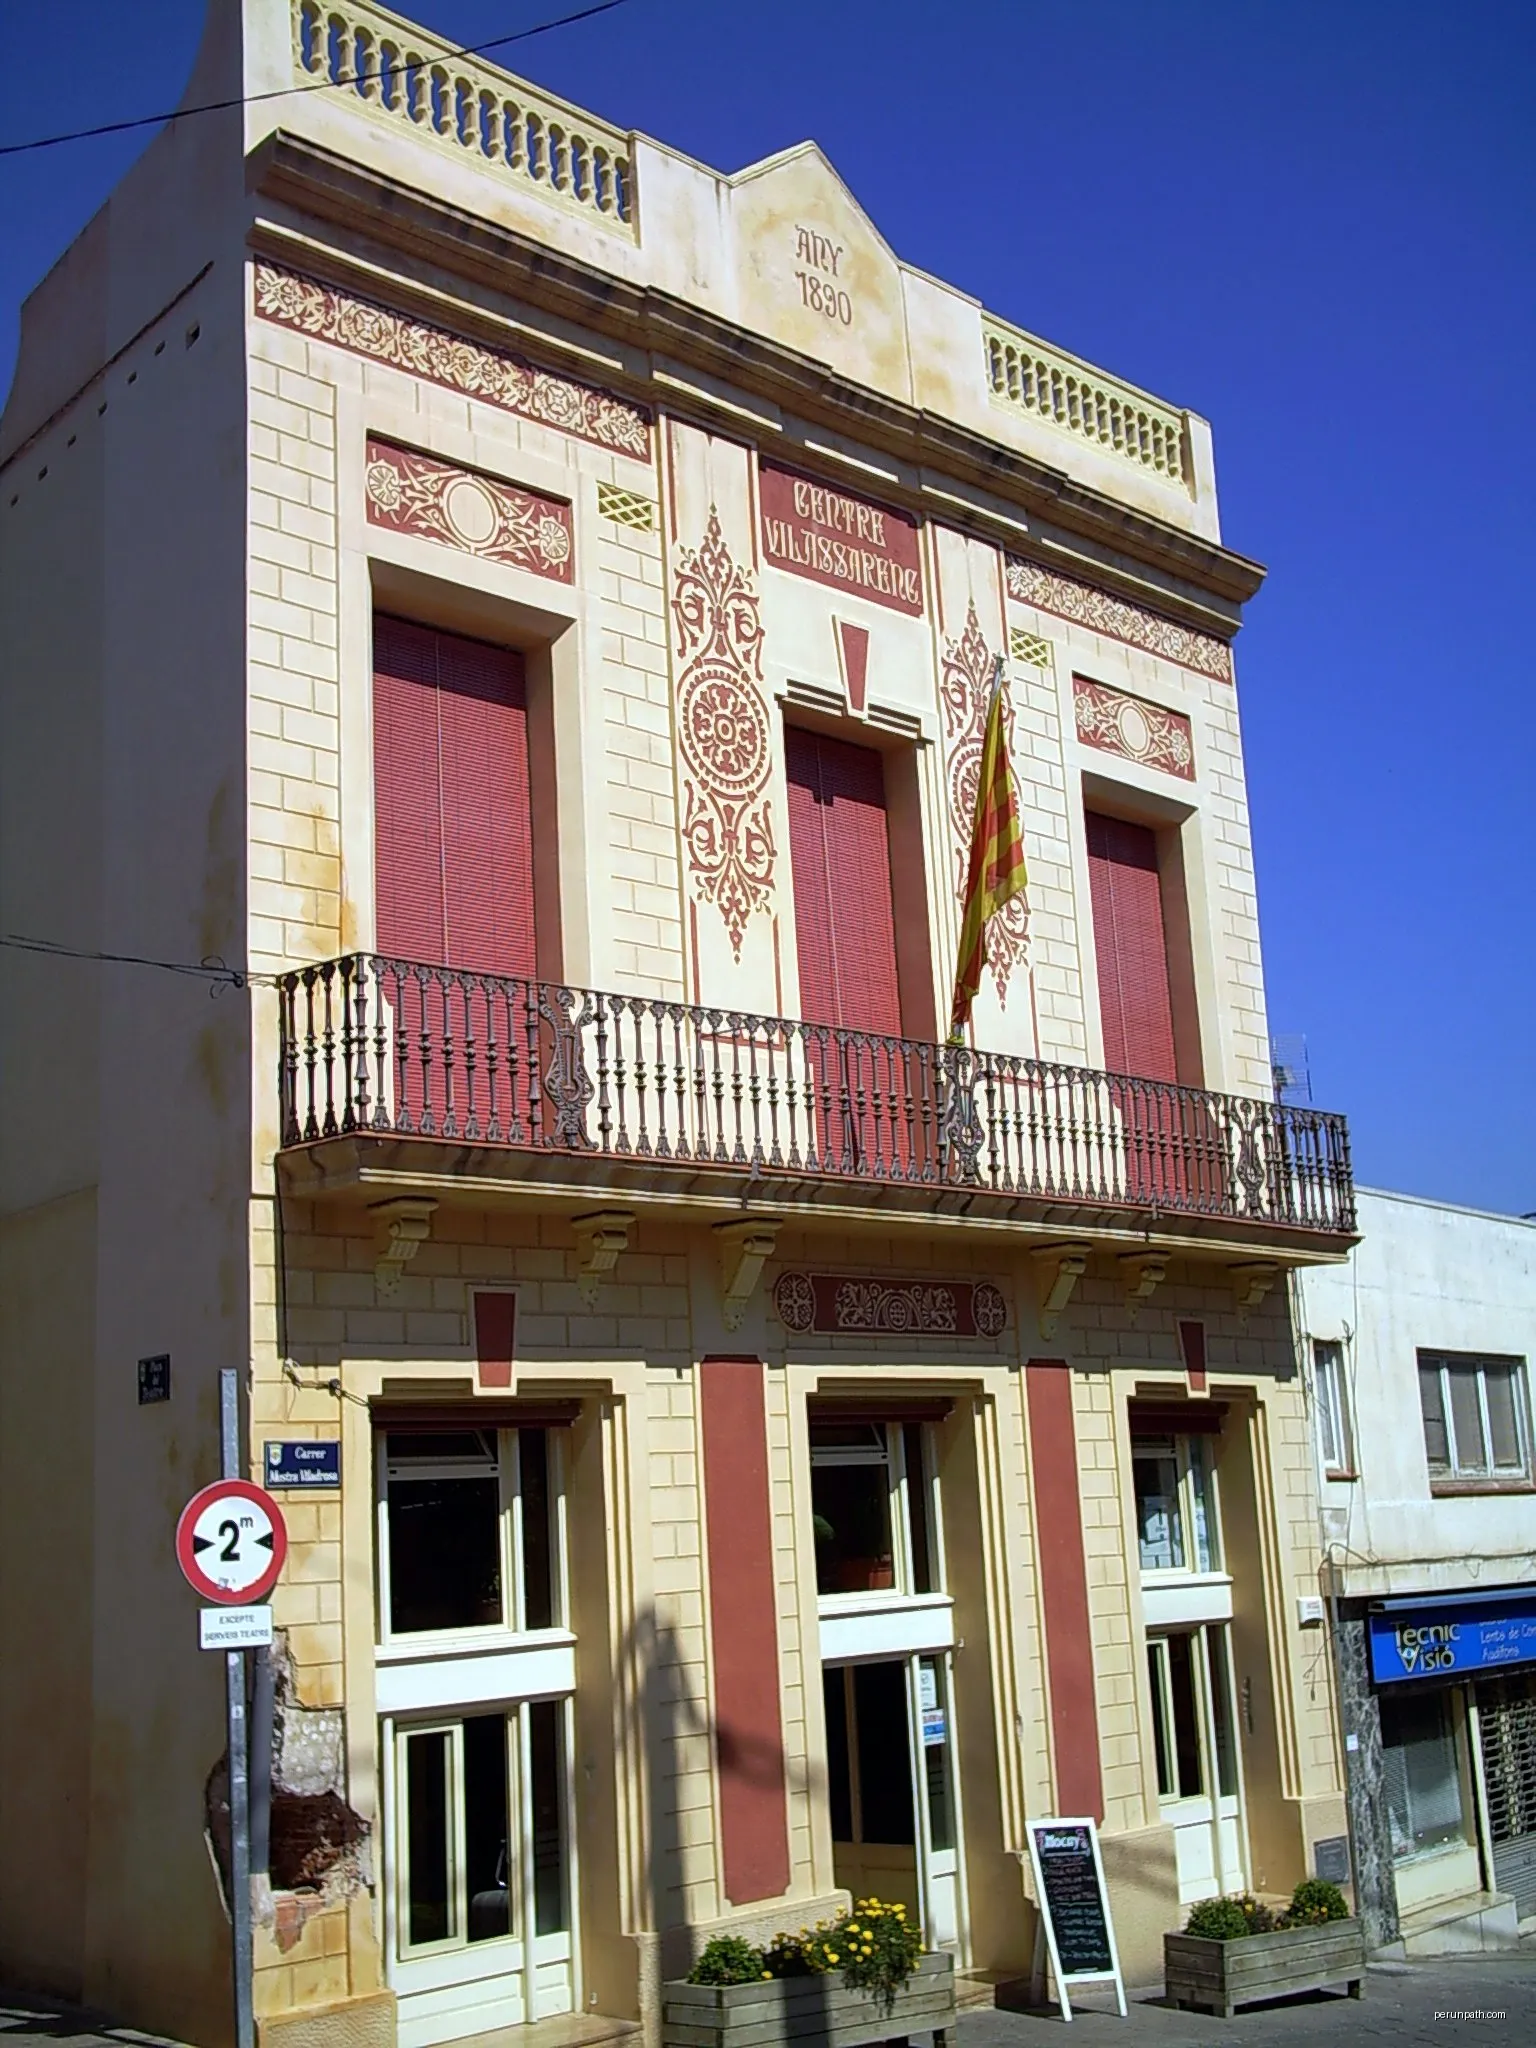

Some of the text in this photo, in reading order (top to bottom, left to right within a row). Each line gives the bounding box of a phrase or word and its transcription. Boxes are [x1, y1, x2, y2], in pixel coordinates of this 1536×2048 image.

[795, 224, 843, 277] ANY
[795, 271, 851, 325] 1890
[794, 481, 886, 548] CENTRE
[294, 1446, 327, 1460] Carrer
[1396, 1644, 1455, 1673] Visió
